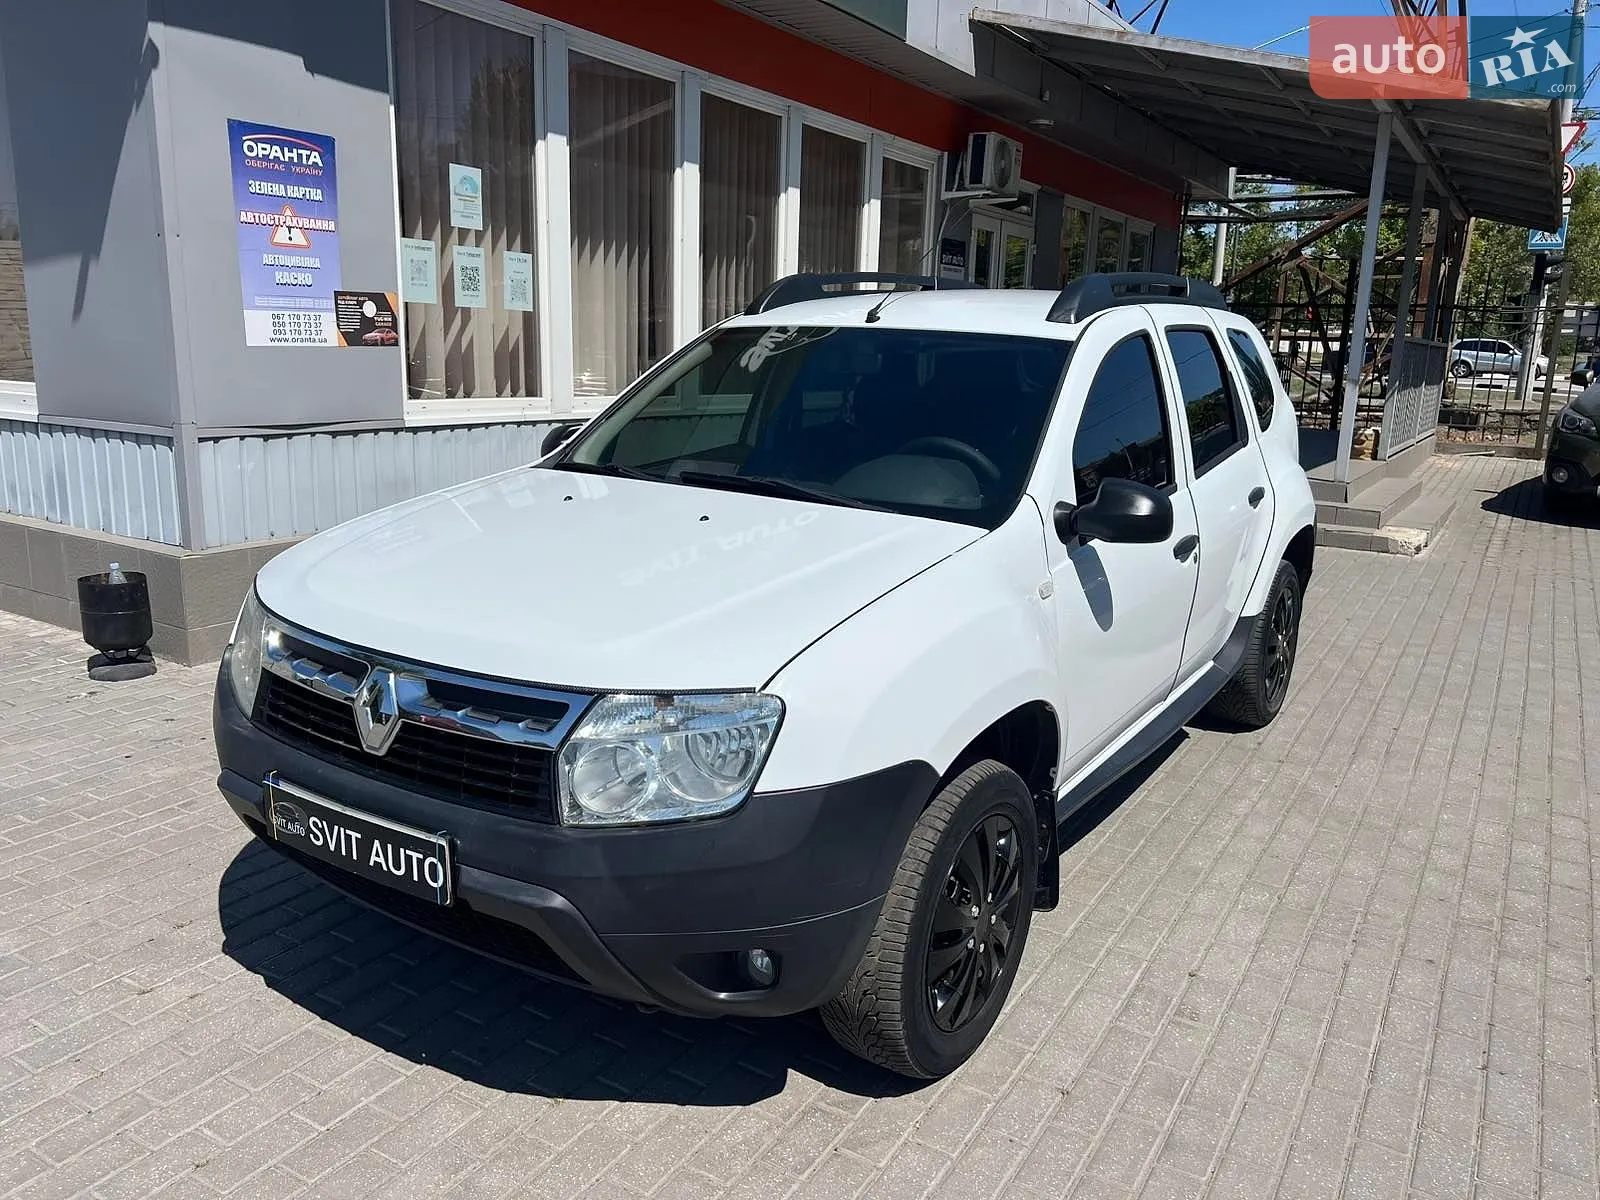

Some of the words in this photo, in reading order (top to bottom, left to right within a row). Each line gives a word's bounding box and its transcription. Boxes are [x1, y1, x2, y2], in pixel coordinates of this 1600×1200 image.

[242, 140, 324, 167] ОРАНТА
[291, 165, 323, 176] УКРАЇНУ
[248, 179, 286, 198] ЗЕЛЕНА
[287, 184, 324, 202] КАРТКА
[240, 210, 336, 233] АВТОСТРАХУВАННЯ
[263, 253, 321, 269] АВТОЦИВІЛКА
[274, 271, 313, 287] КАСКО
[271, 313, 285, 321] 067
[287, 313, 301, 321] 170
[272, 328, 287, 336] 093
[273, 815, 287, 828] SVIT
[287, 821, 306, 837] AUTO
[308, 816, 362, 861] SVIT
[369, 839, 444, 888] AUTO
